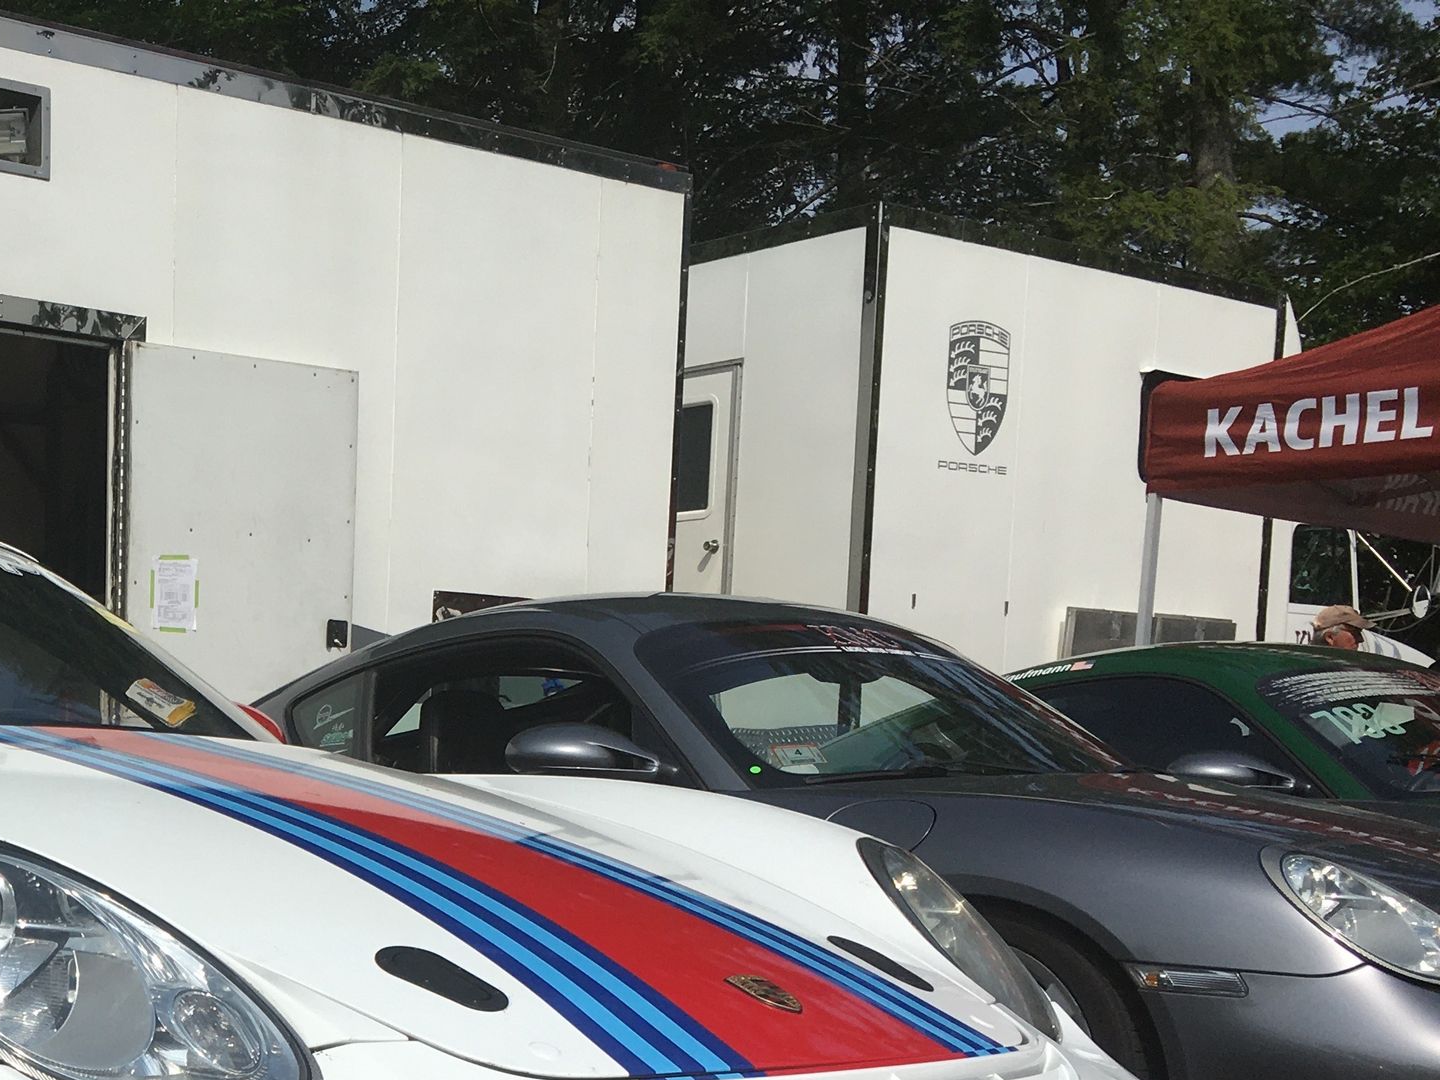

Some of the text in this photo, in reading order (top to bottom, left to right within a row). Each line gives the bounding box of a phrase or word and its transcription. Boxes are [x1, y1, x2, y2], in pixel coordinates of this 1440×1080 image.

[951, 323, 1009, 346] PORSCHE
[1204, 387, 1434, 458] KACHEL
[937, 460, 1007, 475] PORSCHE
